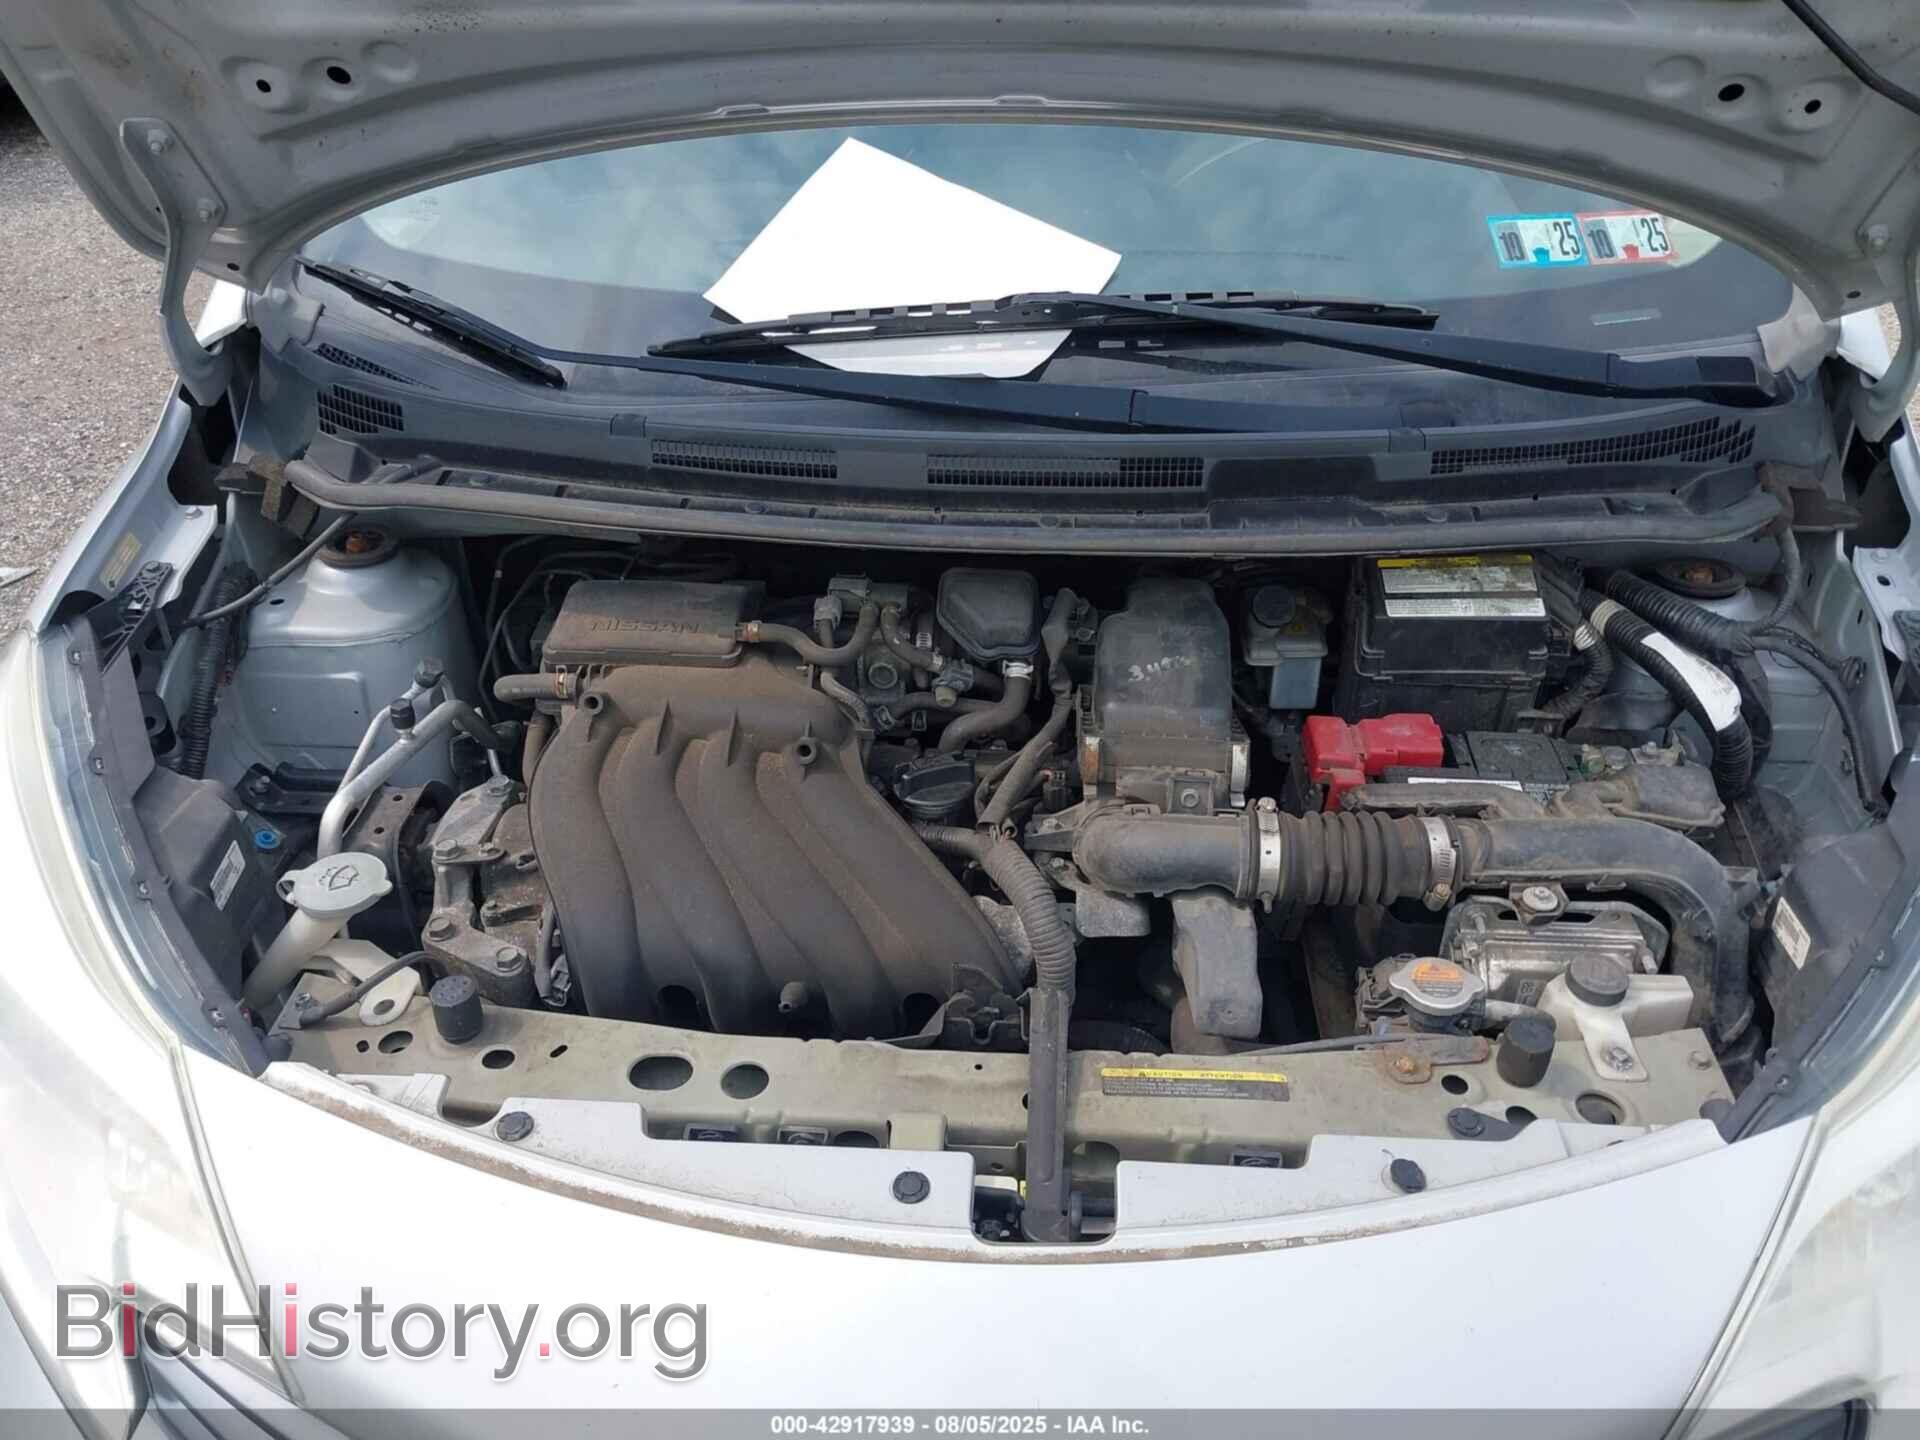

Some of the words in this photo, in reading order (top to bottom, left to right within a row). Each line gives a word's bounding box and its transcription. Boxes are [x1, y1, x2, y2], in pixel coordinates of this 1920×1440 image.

[1554, 221, 1580, 256] 25
[1641, 217, 1669, 252] 25
[591, 618, 702, 634] NISSAN
